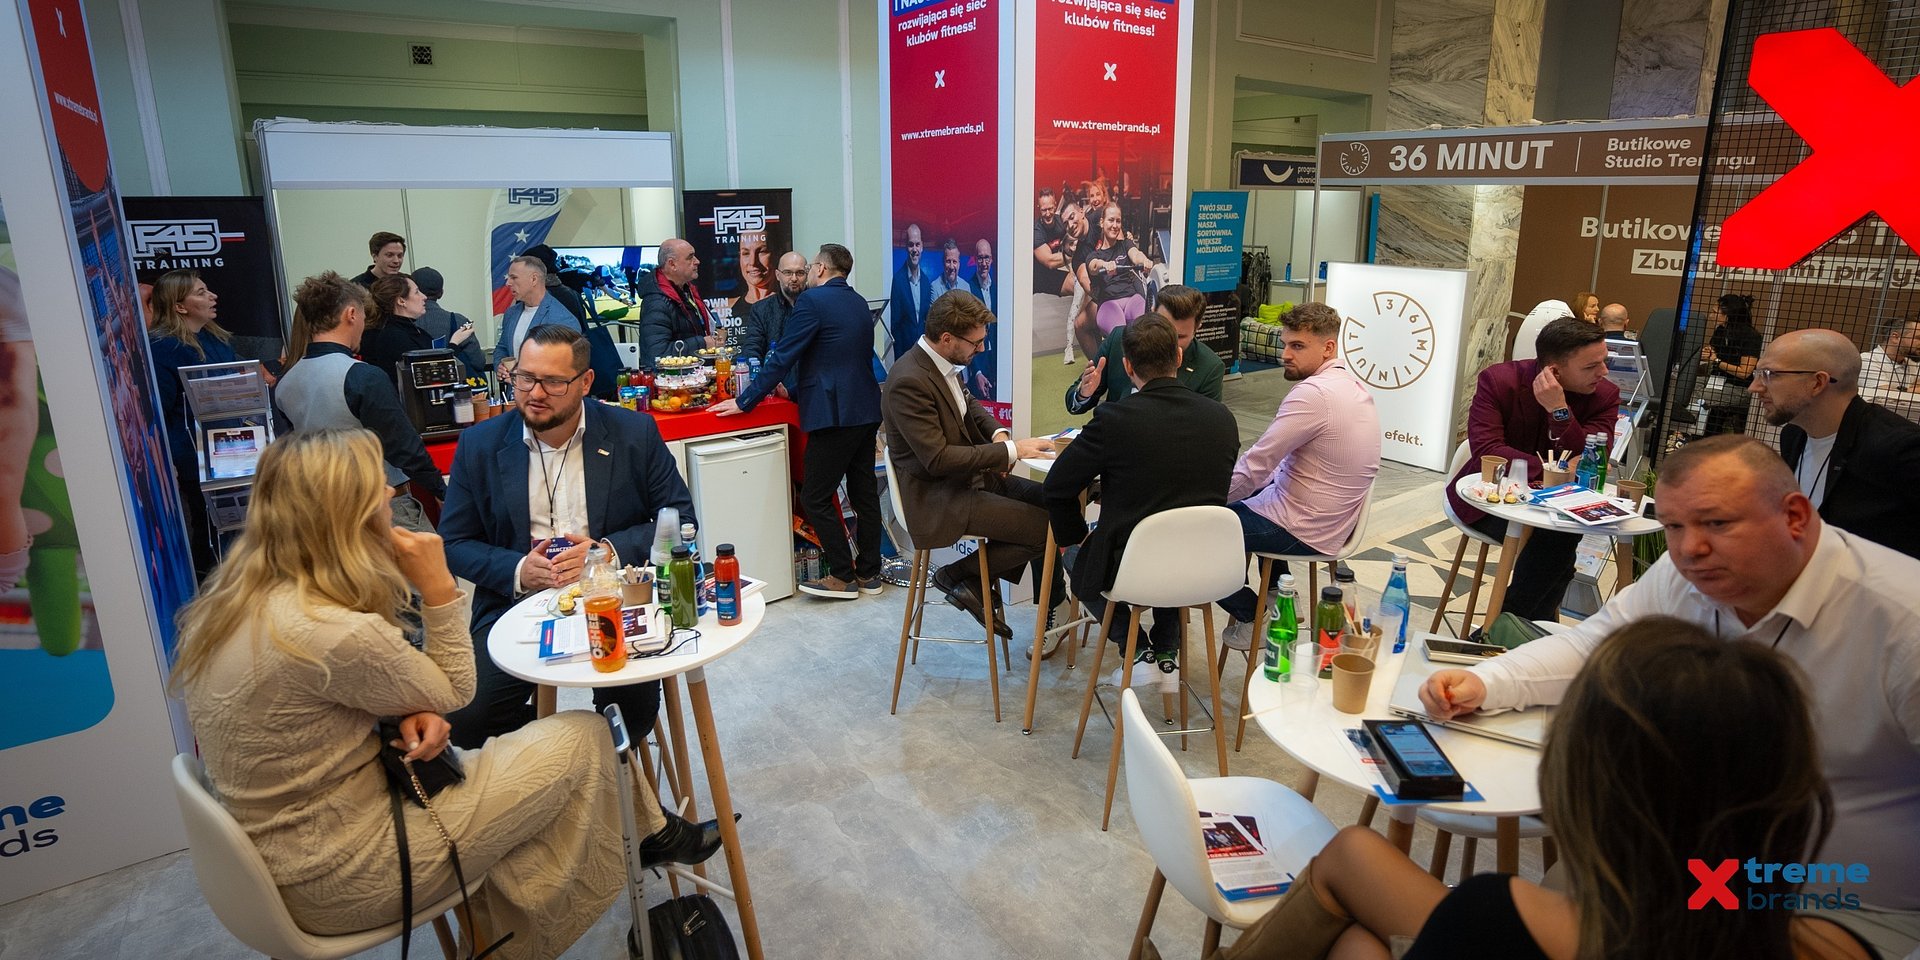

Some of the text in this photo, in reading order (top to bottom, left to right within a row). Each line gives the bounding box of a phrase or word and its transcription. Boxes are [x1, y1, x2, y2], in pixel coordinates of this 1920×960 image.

[898, 9, 947, 31] rozwijająca
[950, 3, 964, 18] się
[1052, 0, 1166, 20] zwijająca się sieć
[906, 18, 977, 47] klubów fitness!
[1064, 11, 1155, 36] klubów fitness!
[901, 121, 985, 141] www.xtremebrands.pl
[1053, 119, 1160, 135] www.xtremebrands.pl
[1607, 137, 1692, 151] Butikowe
[1388, 144, 1427, 171] 36
[1436, 140, 1553, 170] MINUT
[1604, 153, 1756, 170] Studio Trengu
[715, 207, 765, 234] F45
[1197, 221, 1217, 229] NASZA
[130, 221, 219, 255] F45
[715, 234, 767, 244] TRAINING
[134, 258, 225, 270] TRAINING
[1637, 252, 1725, 277] Zbuuj
[1384, 429, 1424, 447] efekt.
[587, 612, 605, 659] OSHEE
